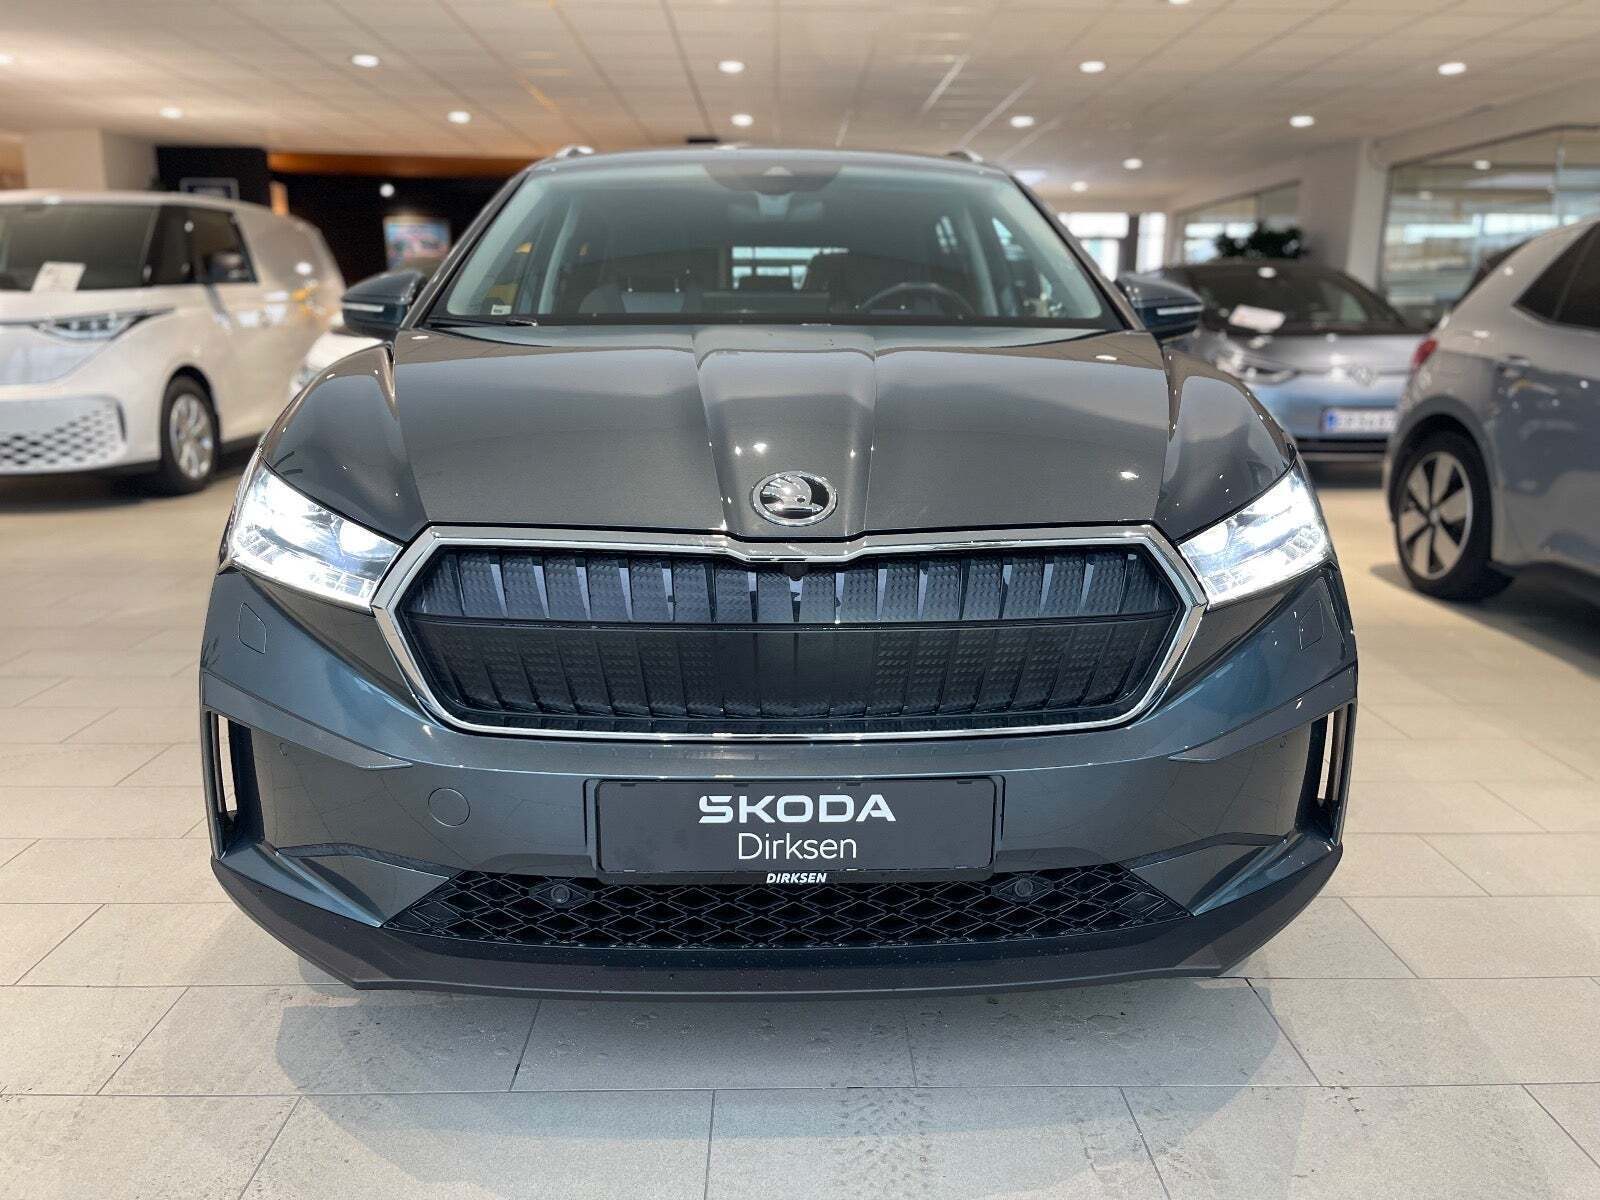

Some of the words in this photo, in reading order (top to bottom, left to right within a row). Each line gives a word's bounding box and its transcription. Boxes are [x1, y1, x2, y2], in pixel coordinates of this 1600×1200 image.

[698, 794, 897, 824] SKODA
[738, 832, 857, 860] Dirksen
[766, 872, 828, 884] DIRKSEN
